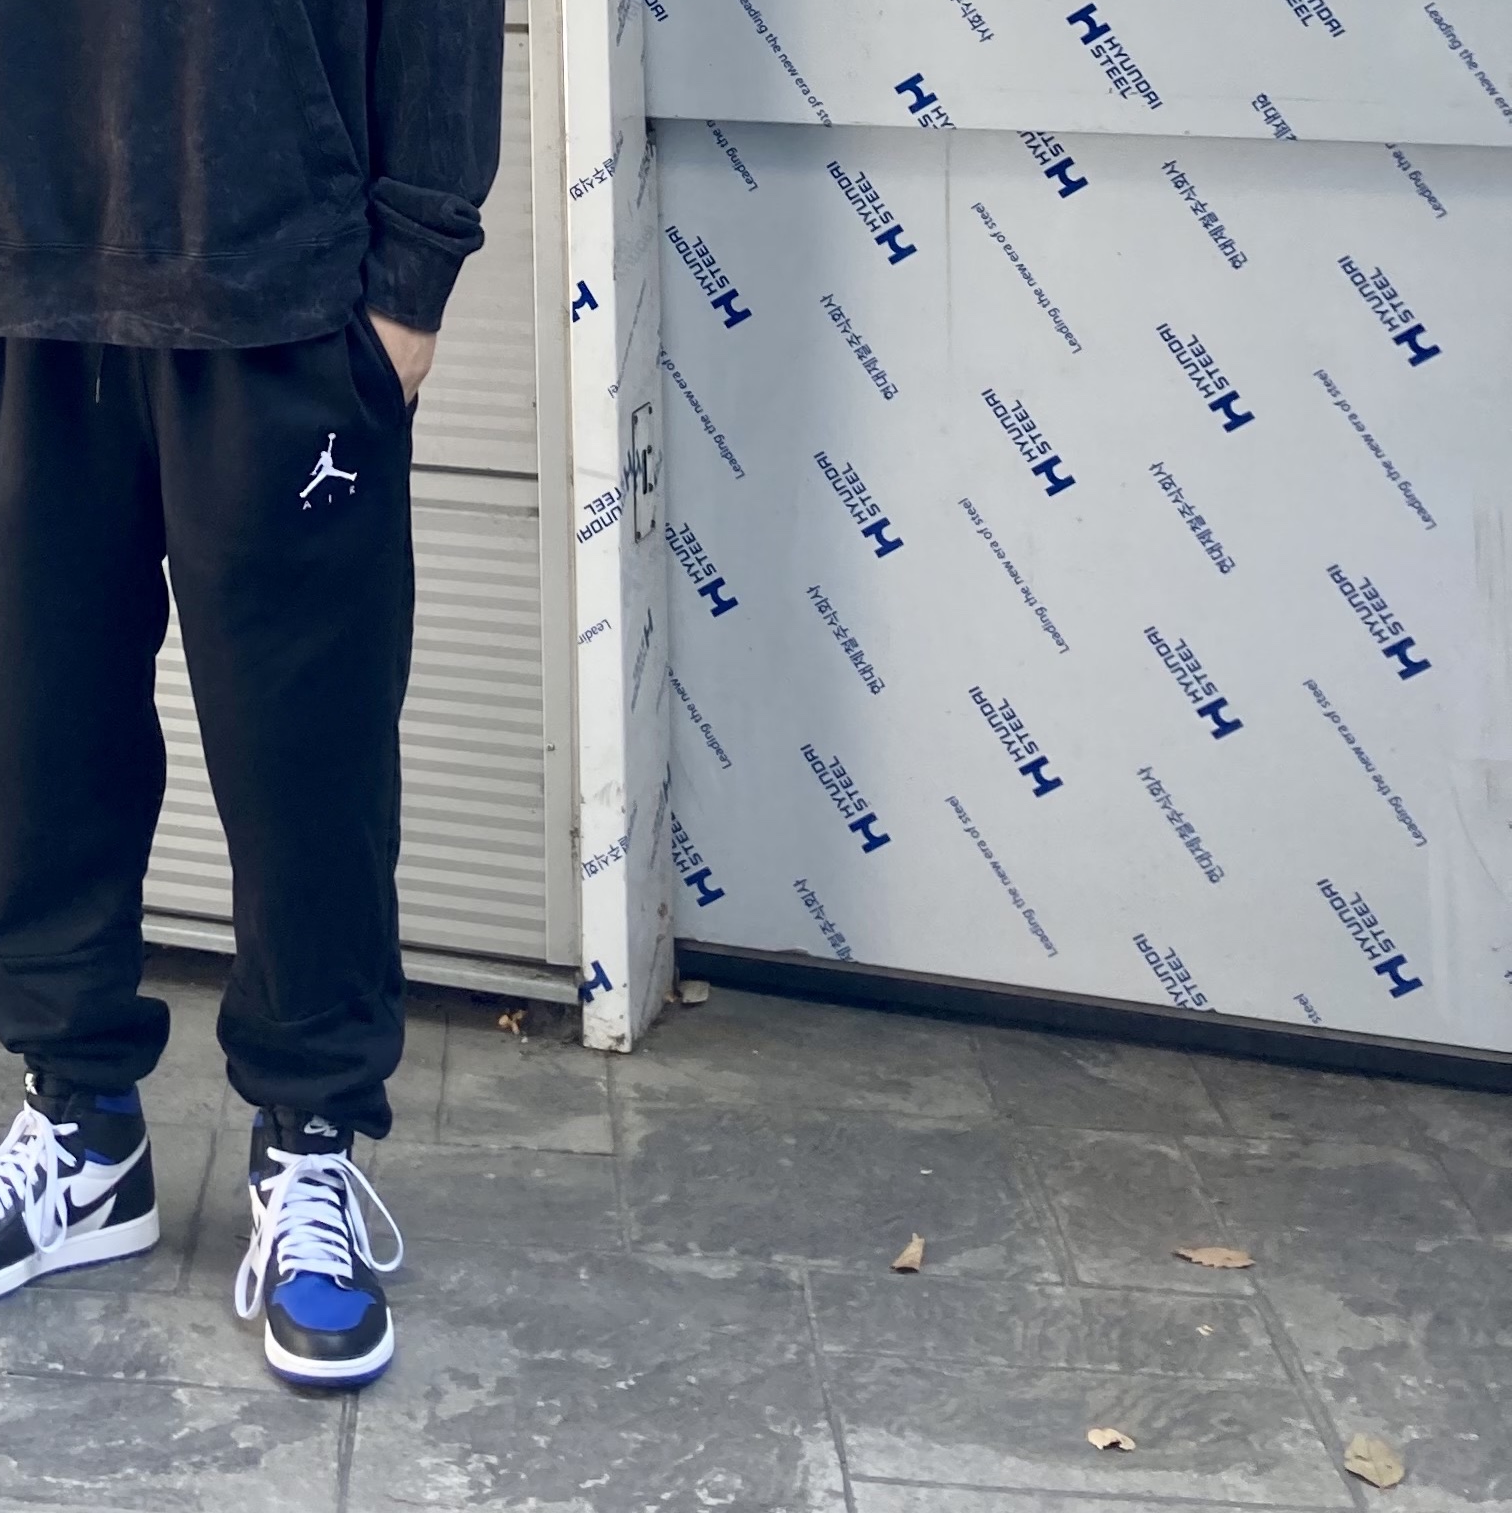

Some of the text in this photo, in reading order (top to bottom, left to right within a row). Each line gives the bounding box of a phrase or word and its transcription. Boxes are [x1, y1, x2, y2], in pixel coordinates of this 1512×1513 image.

[1091, 45, 1134, 99] STEEL
[1103, 36, 1163, 109] HYUNDAI
[827, 161, 887, 240] HYUNDAI
[856, 172, 894, 224] STEEL
[1162, 160, 1247, 269] 현대제철주식회사
[665, 226, 717, 302] HYUNDAI
[693, 236, 729, 288] STEEL
[971, 203, 1082, 353] Leading the new era of steel
[1338, 256, 1400, 339] HYUNDAI
[1373, 267, 1415, 330] STEEL
[820, 294, 898, 400] 현대제철주식회사
[1156, 323, 1222, 407] HYUNDAI
[1188, 335, 1229, 390] STEEL
[982, 389, 1045, 470] HYUNDAI
[1012, 400, 1052, 454] STEEL
[814, 452, 876, 533] HYUNDAI
[843, 462, 881, 516] STEEL
[1149, 462, 1235, 574] 현대제철주식회사
[680, 523, 720, 583] STEEL
[807, 585, 885, 695] 현대제철주식회사
[1327, 565, 1389, 651] HYUNDAI
[1361, 577, 1404, 635] STEEL
[1144, 626, 1206, 711] HYUNDAI
[1176, 638, 1218, 696] STEEL
[969, 686, 1029, 769] HYUNDAI
[999, 698, 1039, 754] STEEL
[800, 744, 859, 826] HYUNDAI
[830, 756, 868, 811] STEEL
[1137, 767, 1224, 883] 현대제철주식회사
[1317, 879, 1384, 960] HYUNDAI
[1352, 892, 1395, 953] STEEL
[1165, 947, 1207, 1005] STEEL
